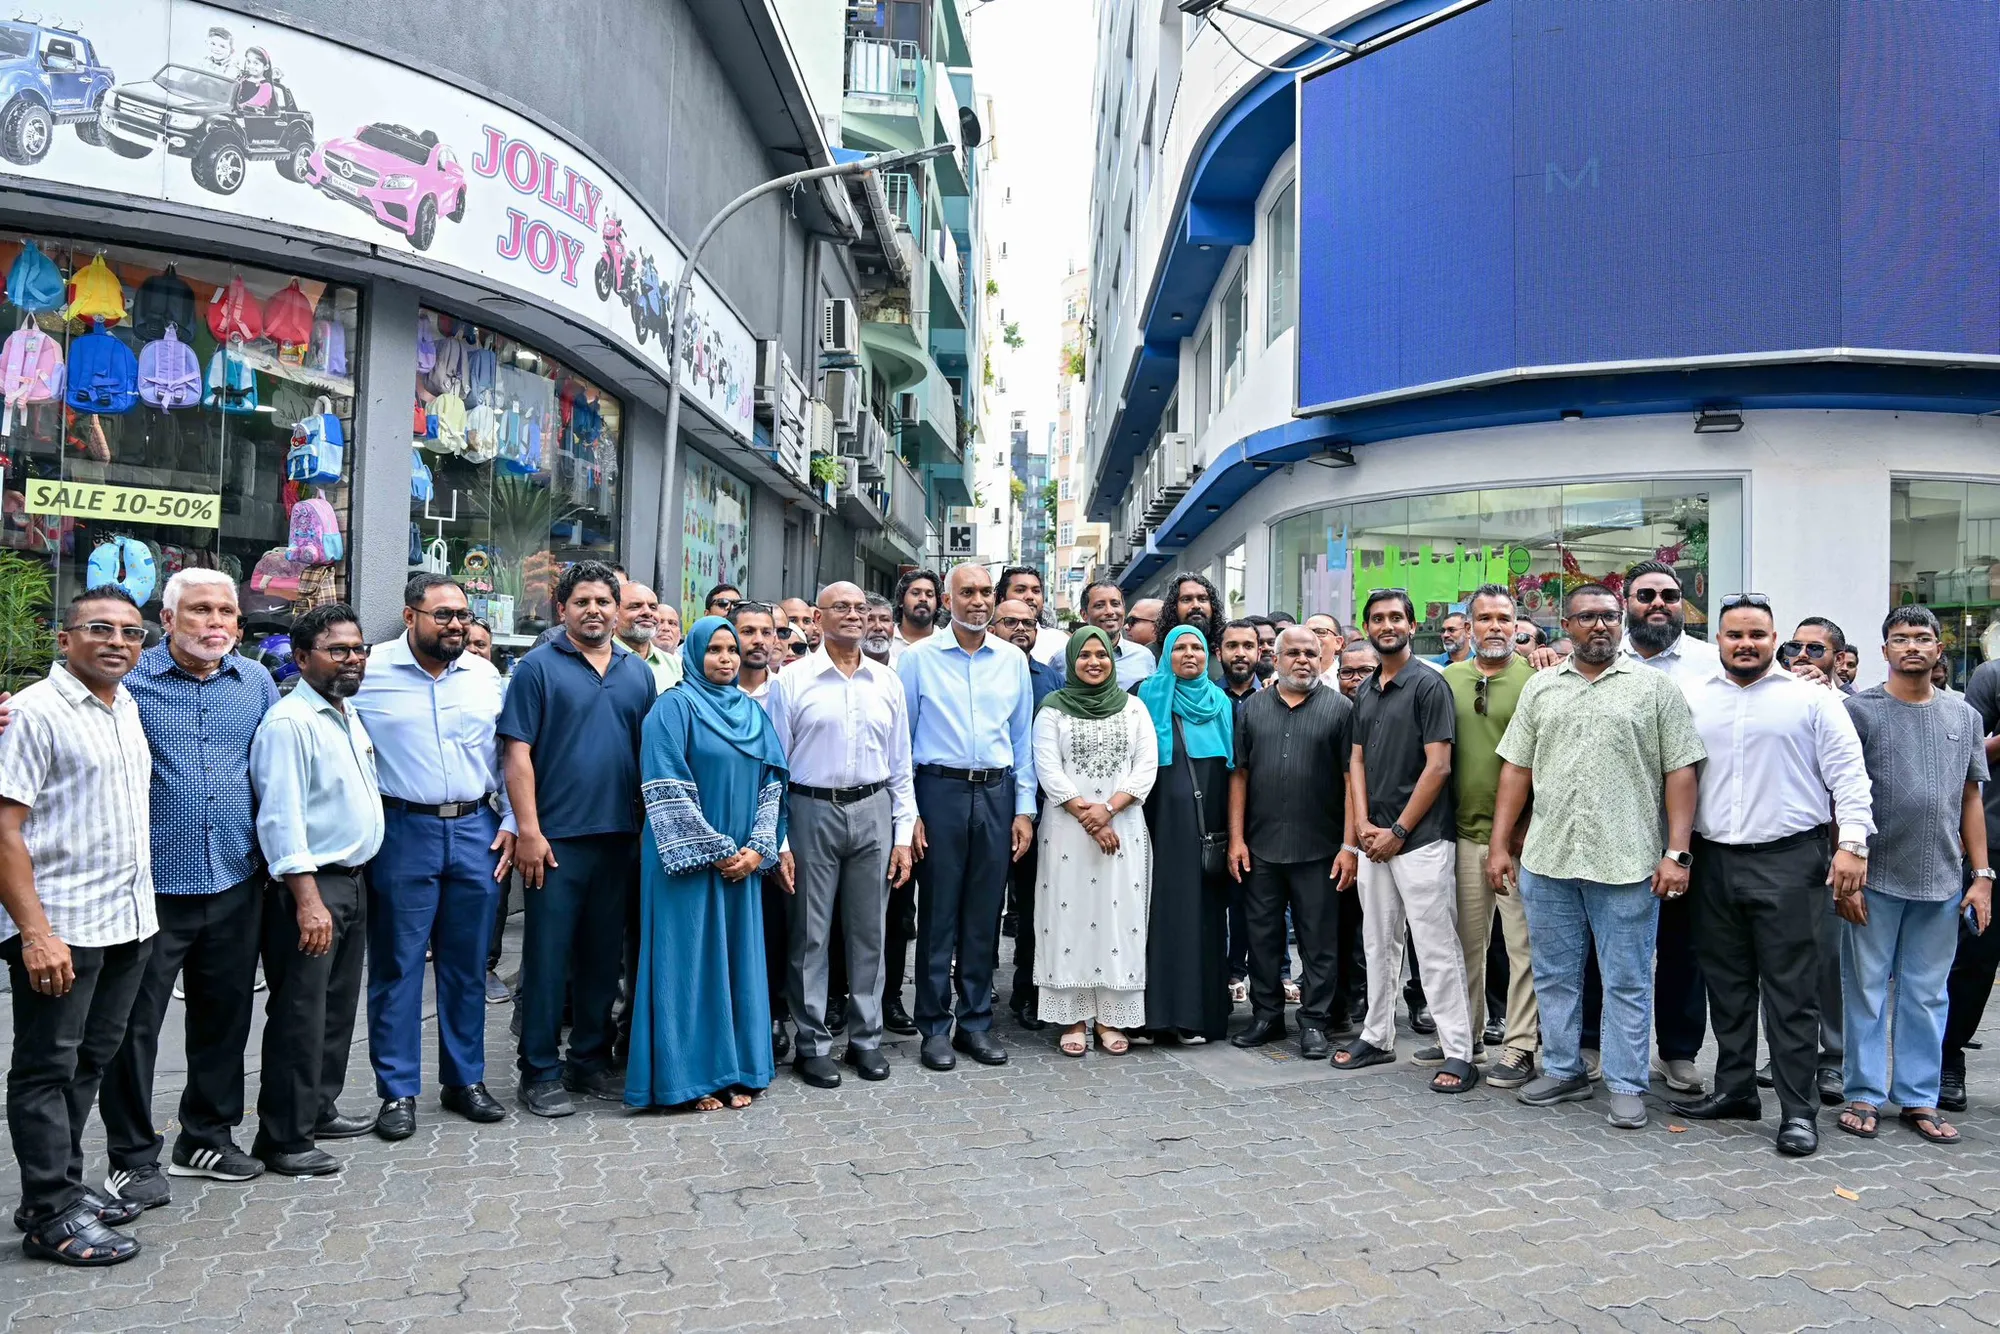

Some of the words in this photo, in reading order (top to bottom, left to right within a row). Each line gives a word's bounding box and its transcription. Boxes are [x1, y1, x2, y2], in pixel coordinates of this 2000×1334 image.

[472, 124, 603, 233] JOLLY
[496, 207, 584, 288] JOY
[33, 486, 106, 511] SALE
[112, 493, 214, 520] 10-50%
